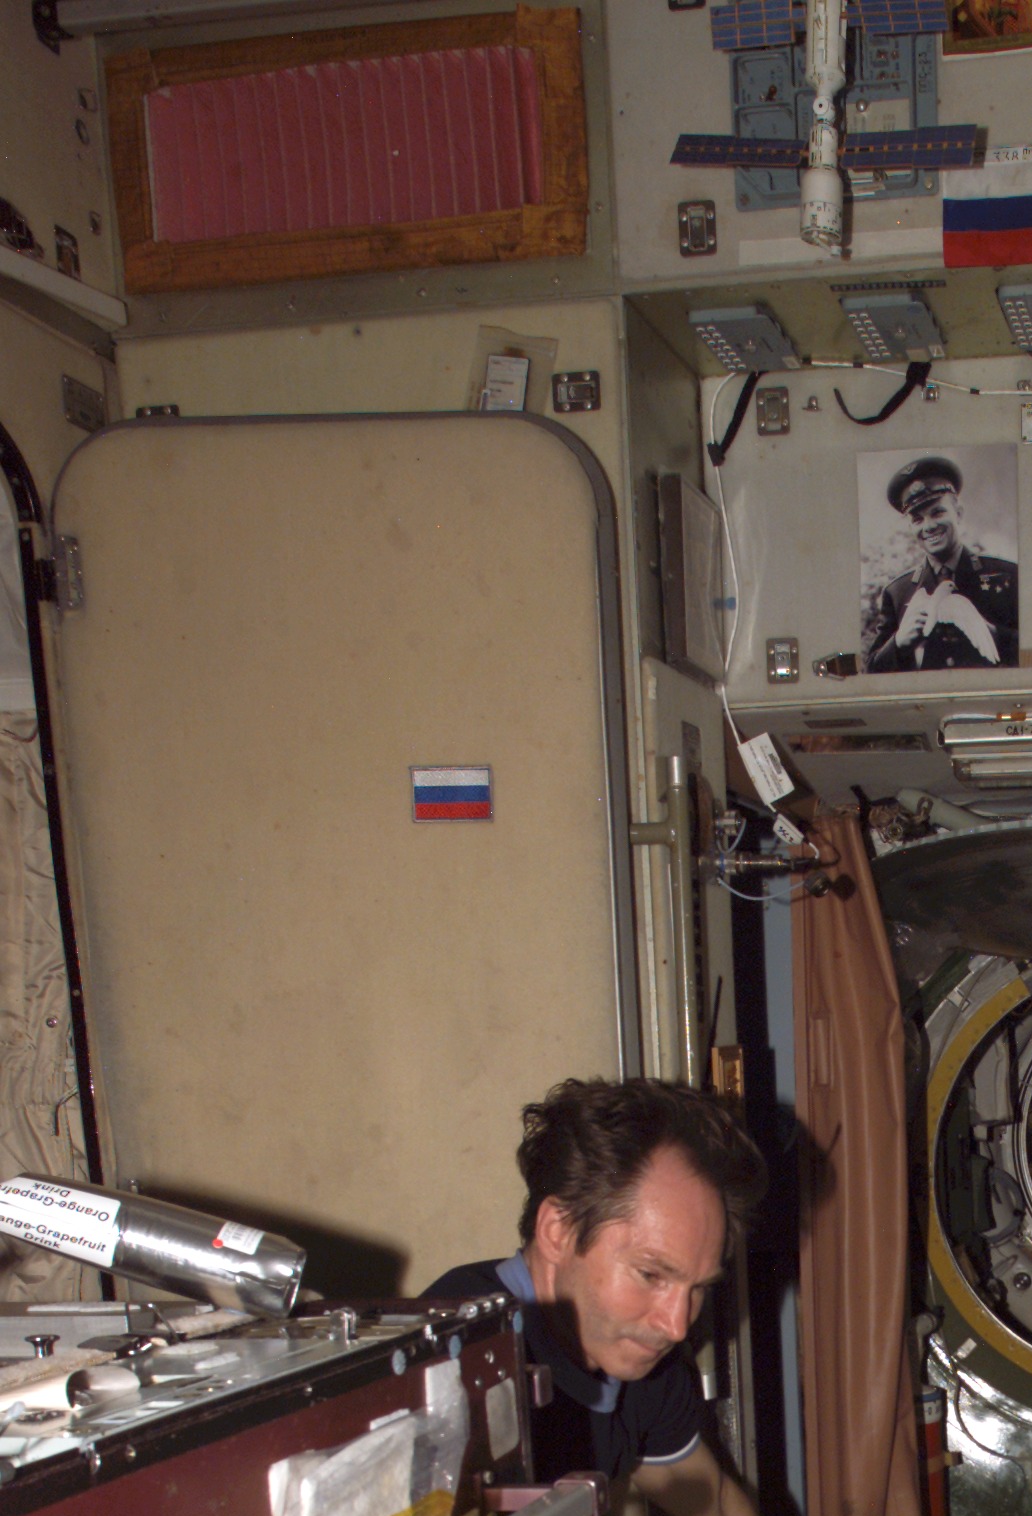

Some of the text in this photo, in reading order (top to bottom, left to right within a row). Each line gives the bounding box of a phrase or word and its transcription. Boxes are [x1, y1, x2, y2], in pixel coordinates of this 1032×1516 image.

[33, 1182, 72, 1198] Drink
[0, 1184, 110, 1222] Orange-Grapefr
[24, 1232, 61, 1249] Drink
